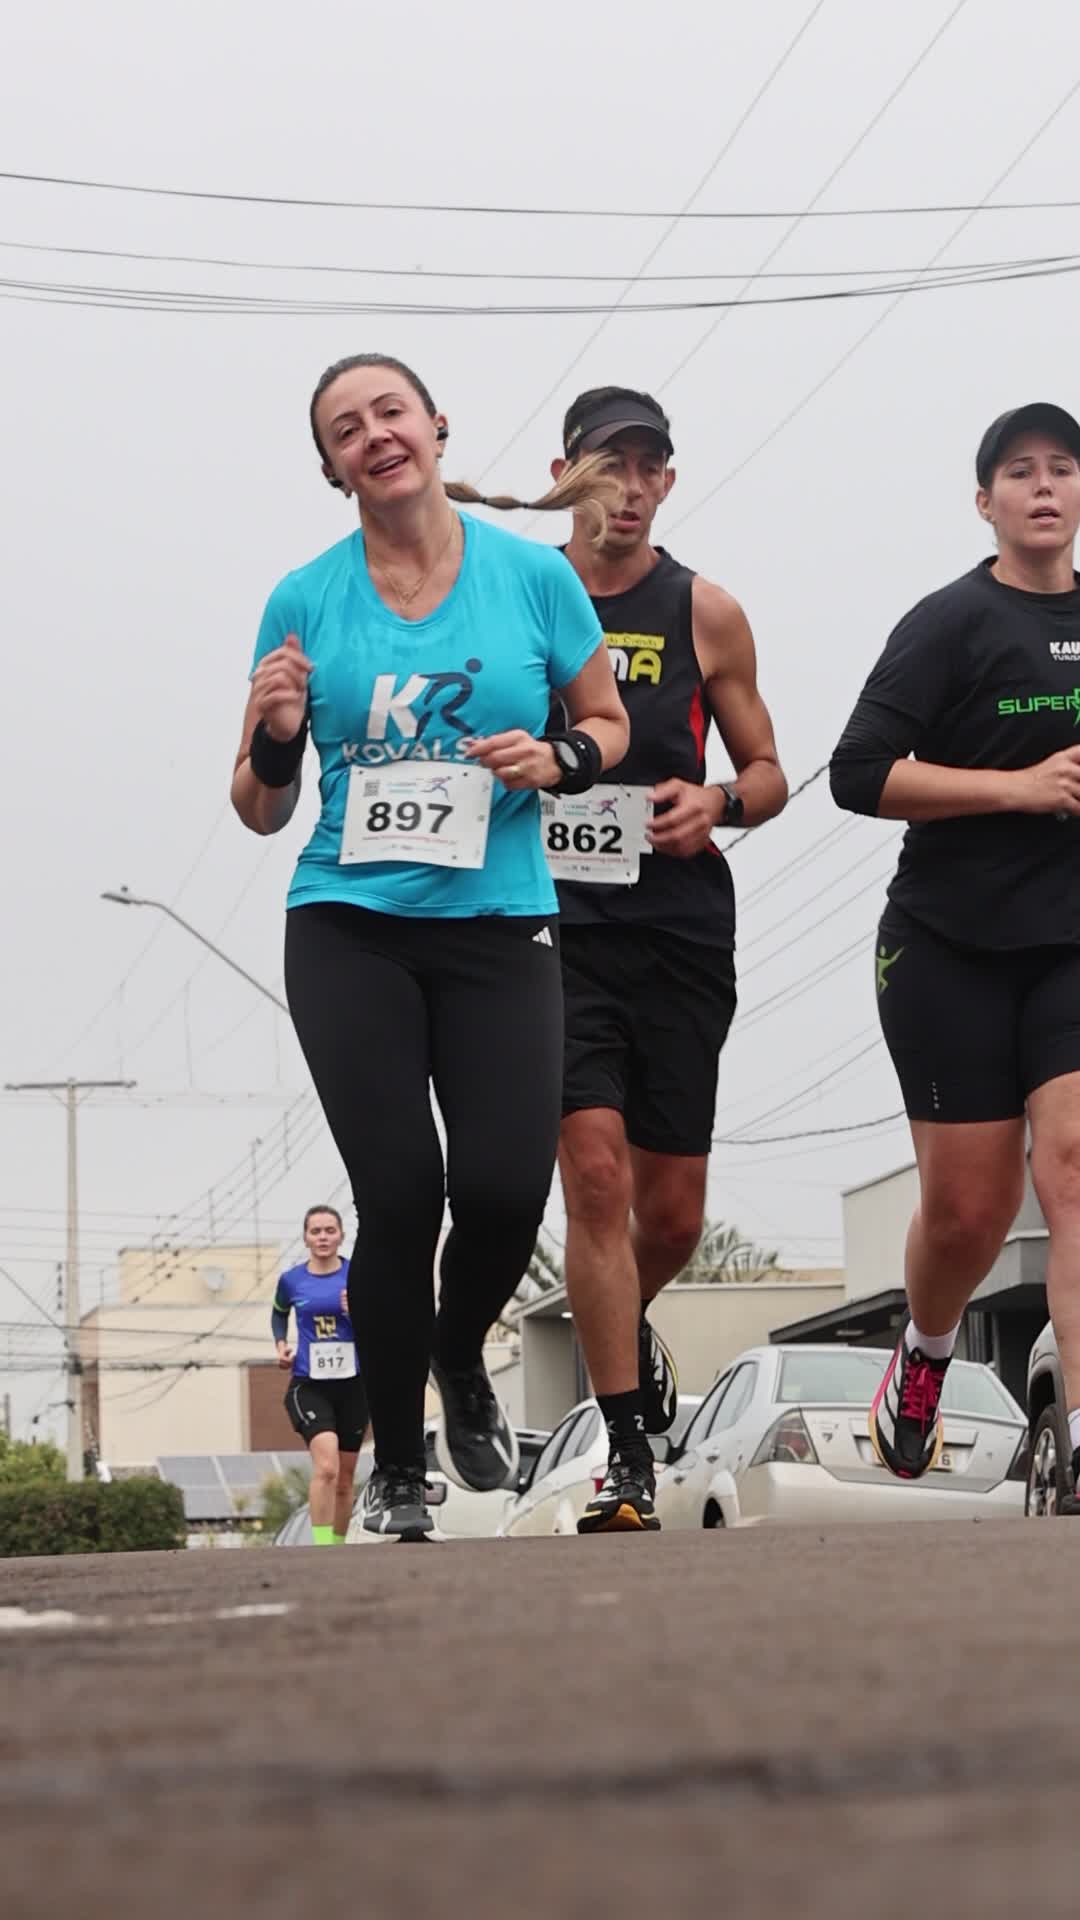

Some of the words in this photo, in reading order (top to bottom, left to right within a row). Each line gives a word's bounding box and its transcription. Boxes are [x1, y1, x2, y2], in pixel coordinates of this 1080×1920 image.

[342, 736, 485, 763] KOVALS
[366, 800, 454, 834] 897
[547, 821, 623, 854] 862
[317, 1356, 344, 1369] 817
